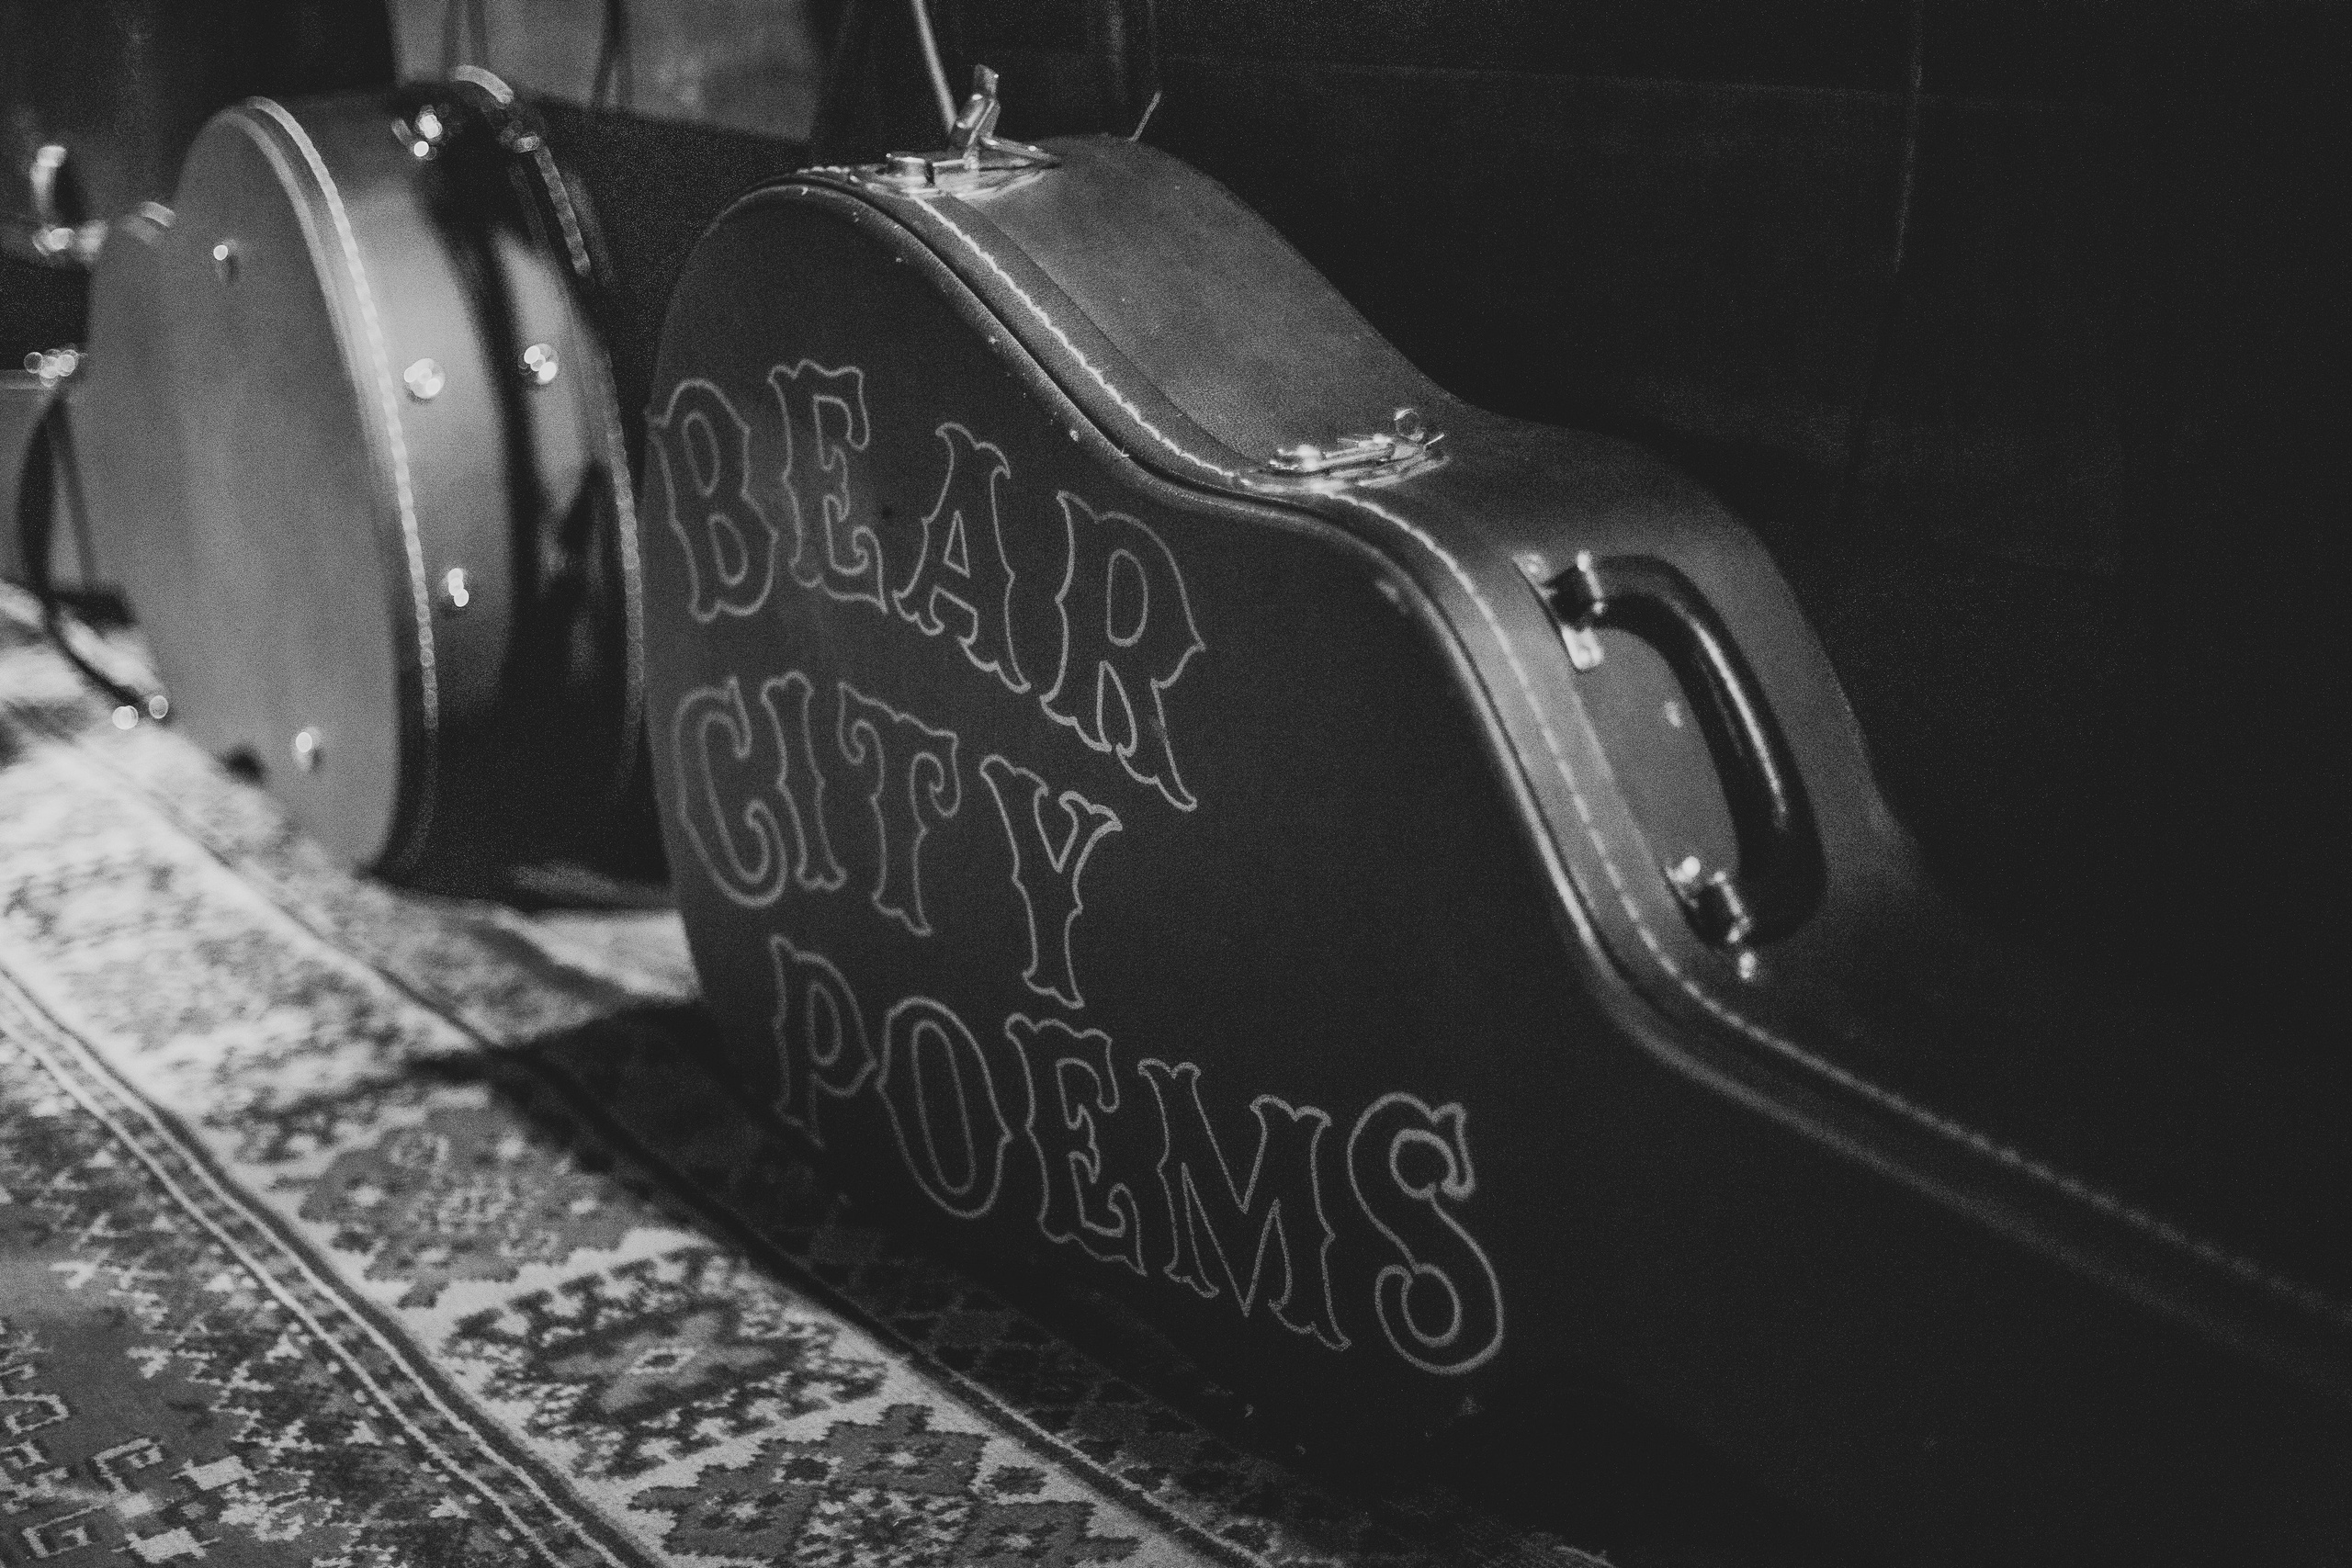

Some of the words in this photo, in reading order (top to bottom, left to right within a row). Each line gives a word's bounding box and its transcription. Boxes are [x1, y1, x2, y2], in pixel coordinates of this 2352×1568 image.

[644, 359, 1206, 812] BEAR
[673, 671, 1123, 1010] CITY
[768, 933, 1505, 1376] POEMS
